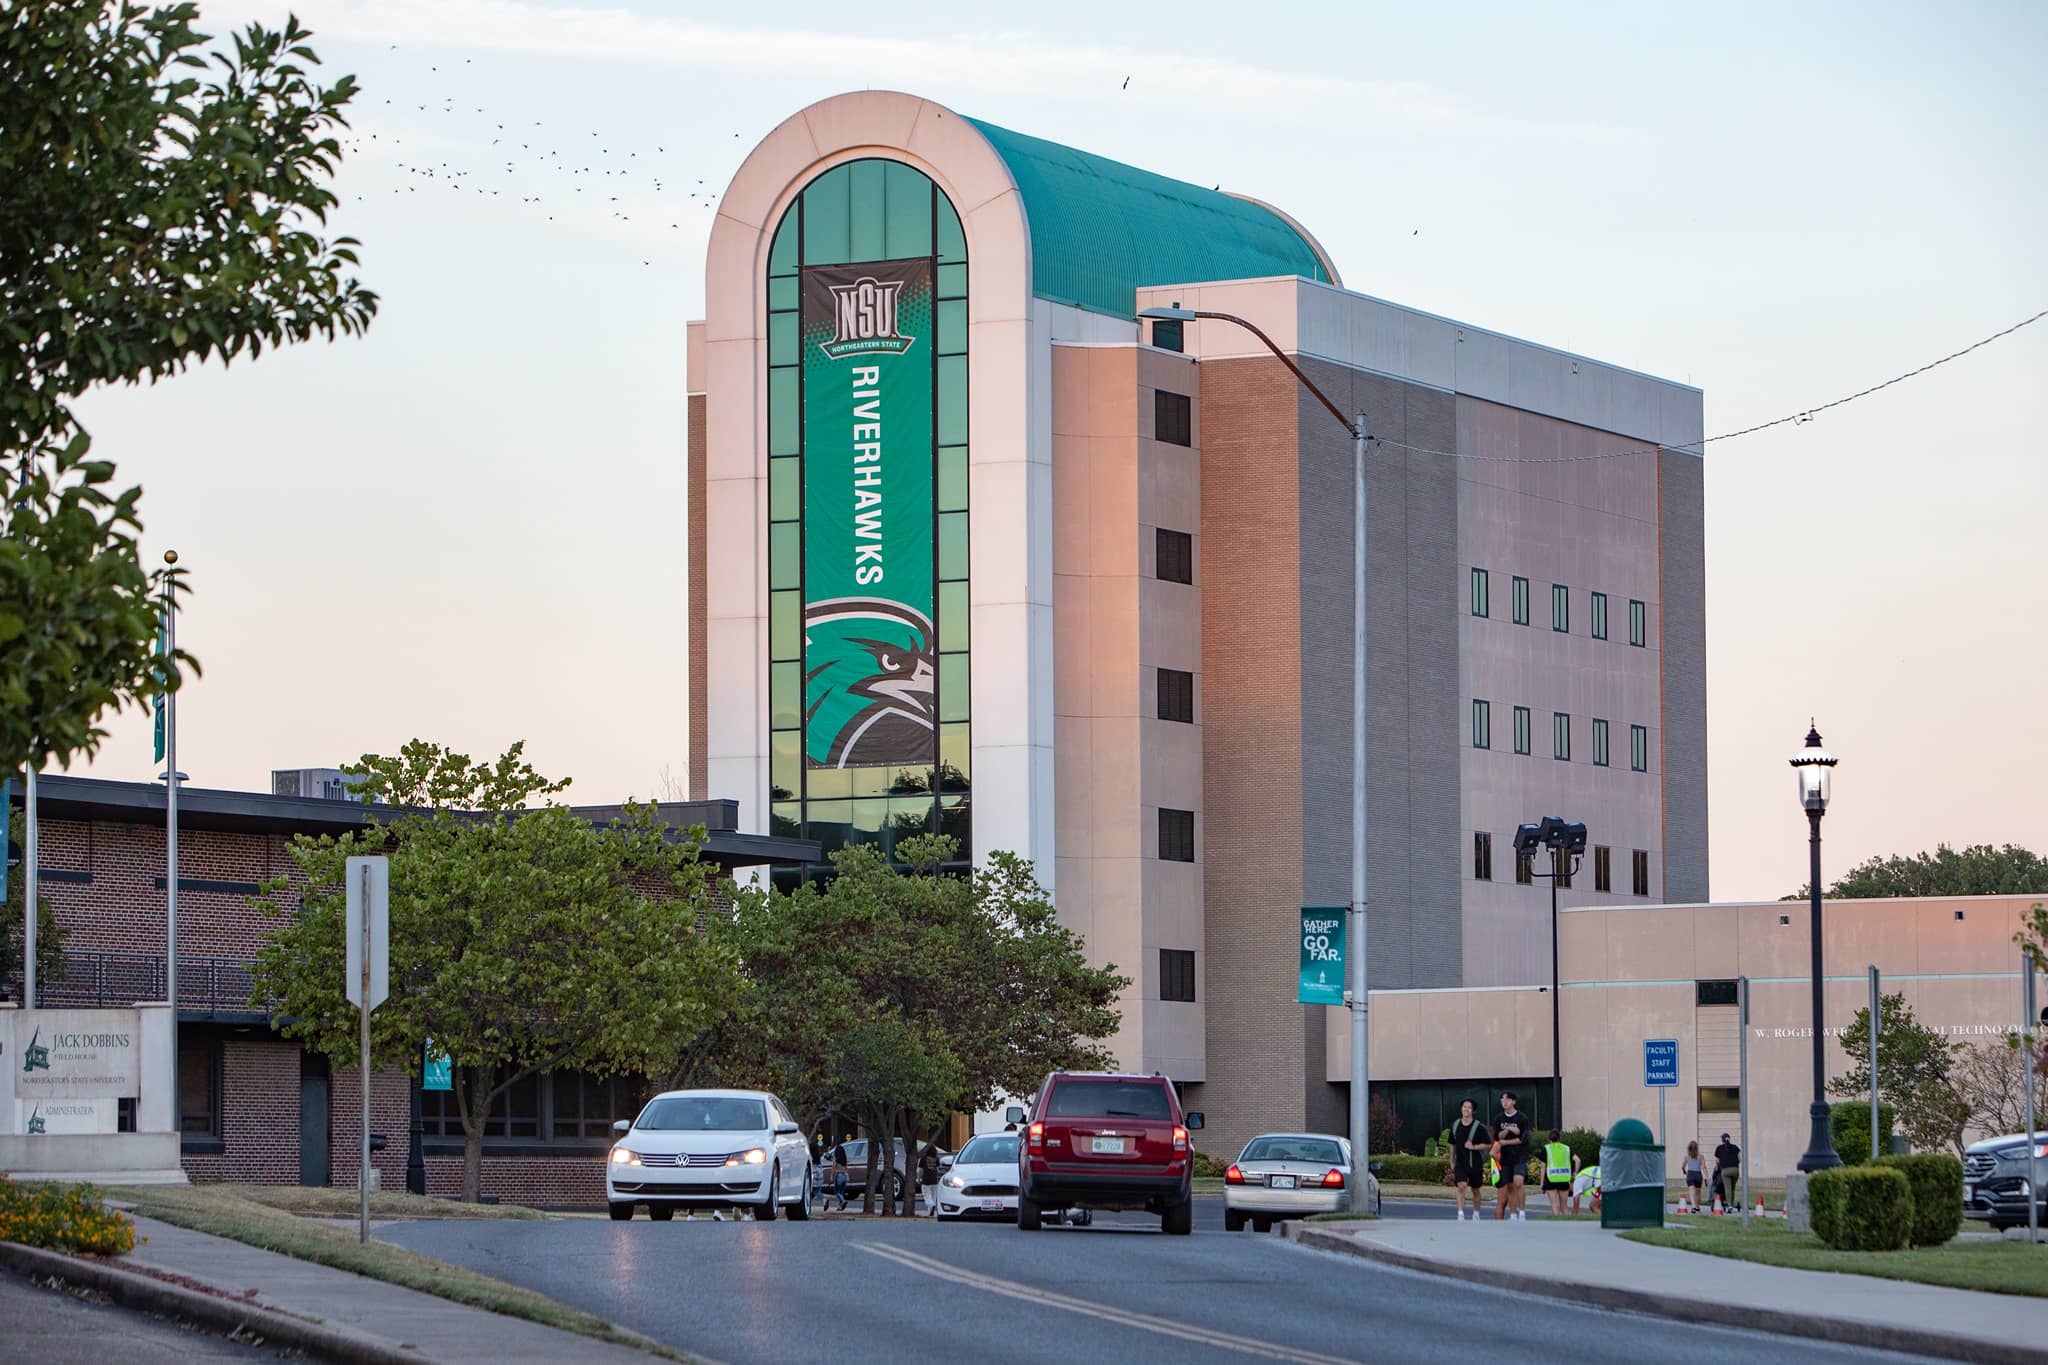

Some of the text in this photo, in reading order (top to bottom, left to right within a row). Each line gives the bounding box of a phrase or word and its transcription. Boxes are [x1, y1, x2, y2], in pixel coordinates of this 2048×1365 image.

[840, 284, 893, 341] NSU
[832, 340, 901, 353] NORTHEASTERN STATE
[852, 366, 884, 585] RIVERHAWKS
[1303, 920, 1339, 928] GATHER
[1303, 936, 1329, 950] GO
[1310, 949, 1341, 960] FAR.
[52, 1033, 129, 1052] JACK DOBBINS
[1647, 1046, 1674, 1055] FACULTY
[1651, 1059, 1671, 1067] STAFF
[1647, 1072, 1675, 1080] PARKING
